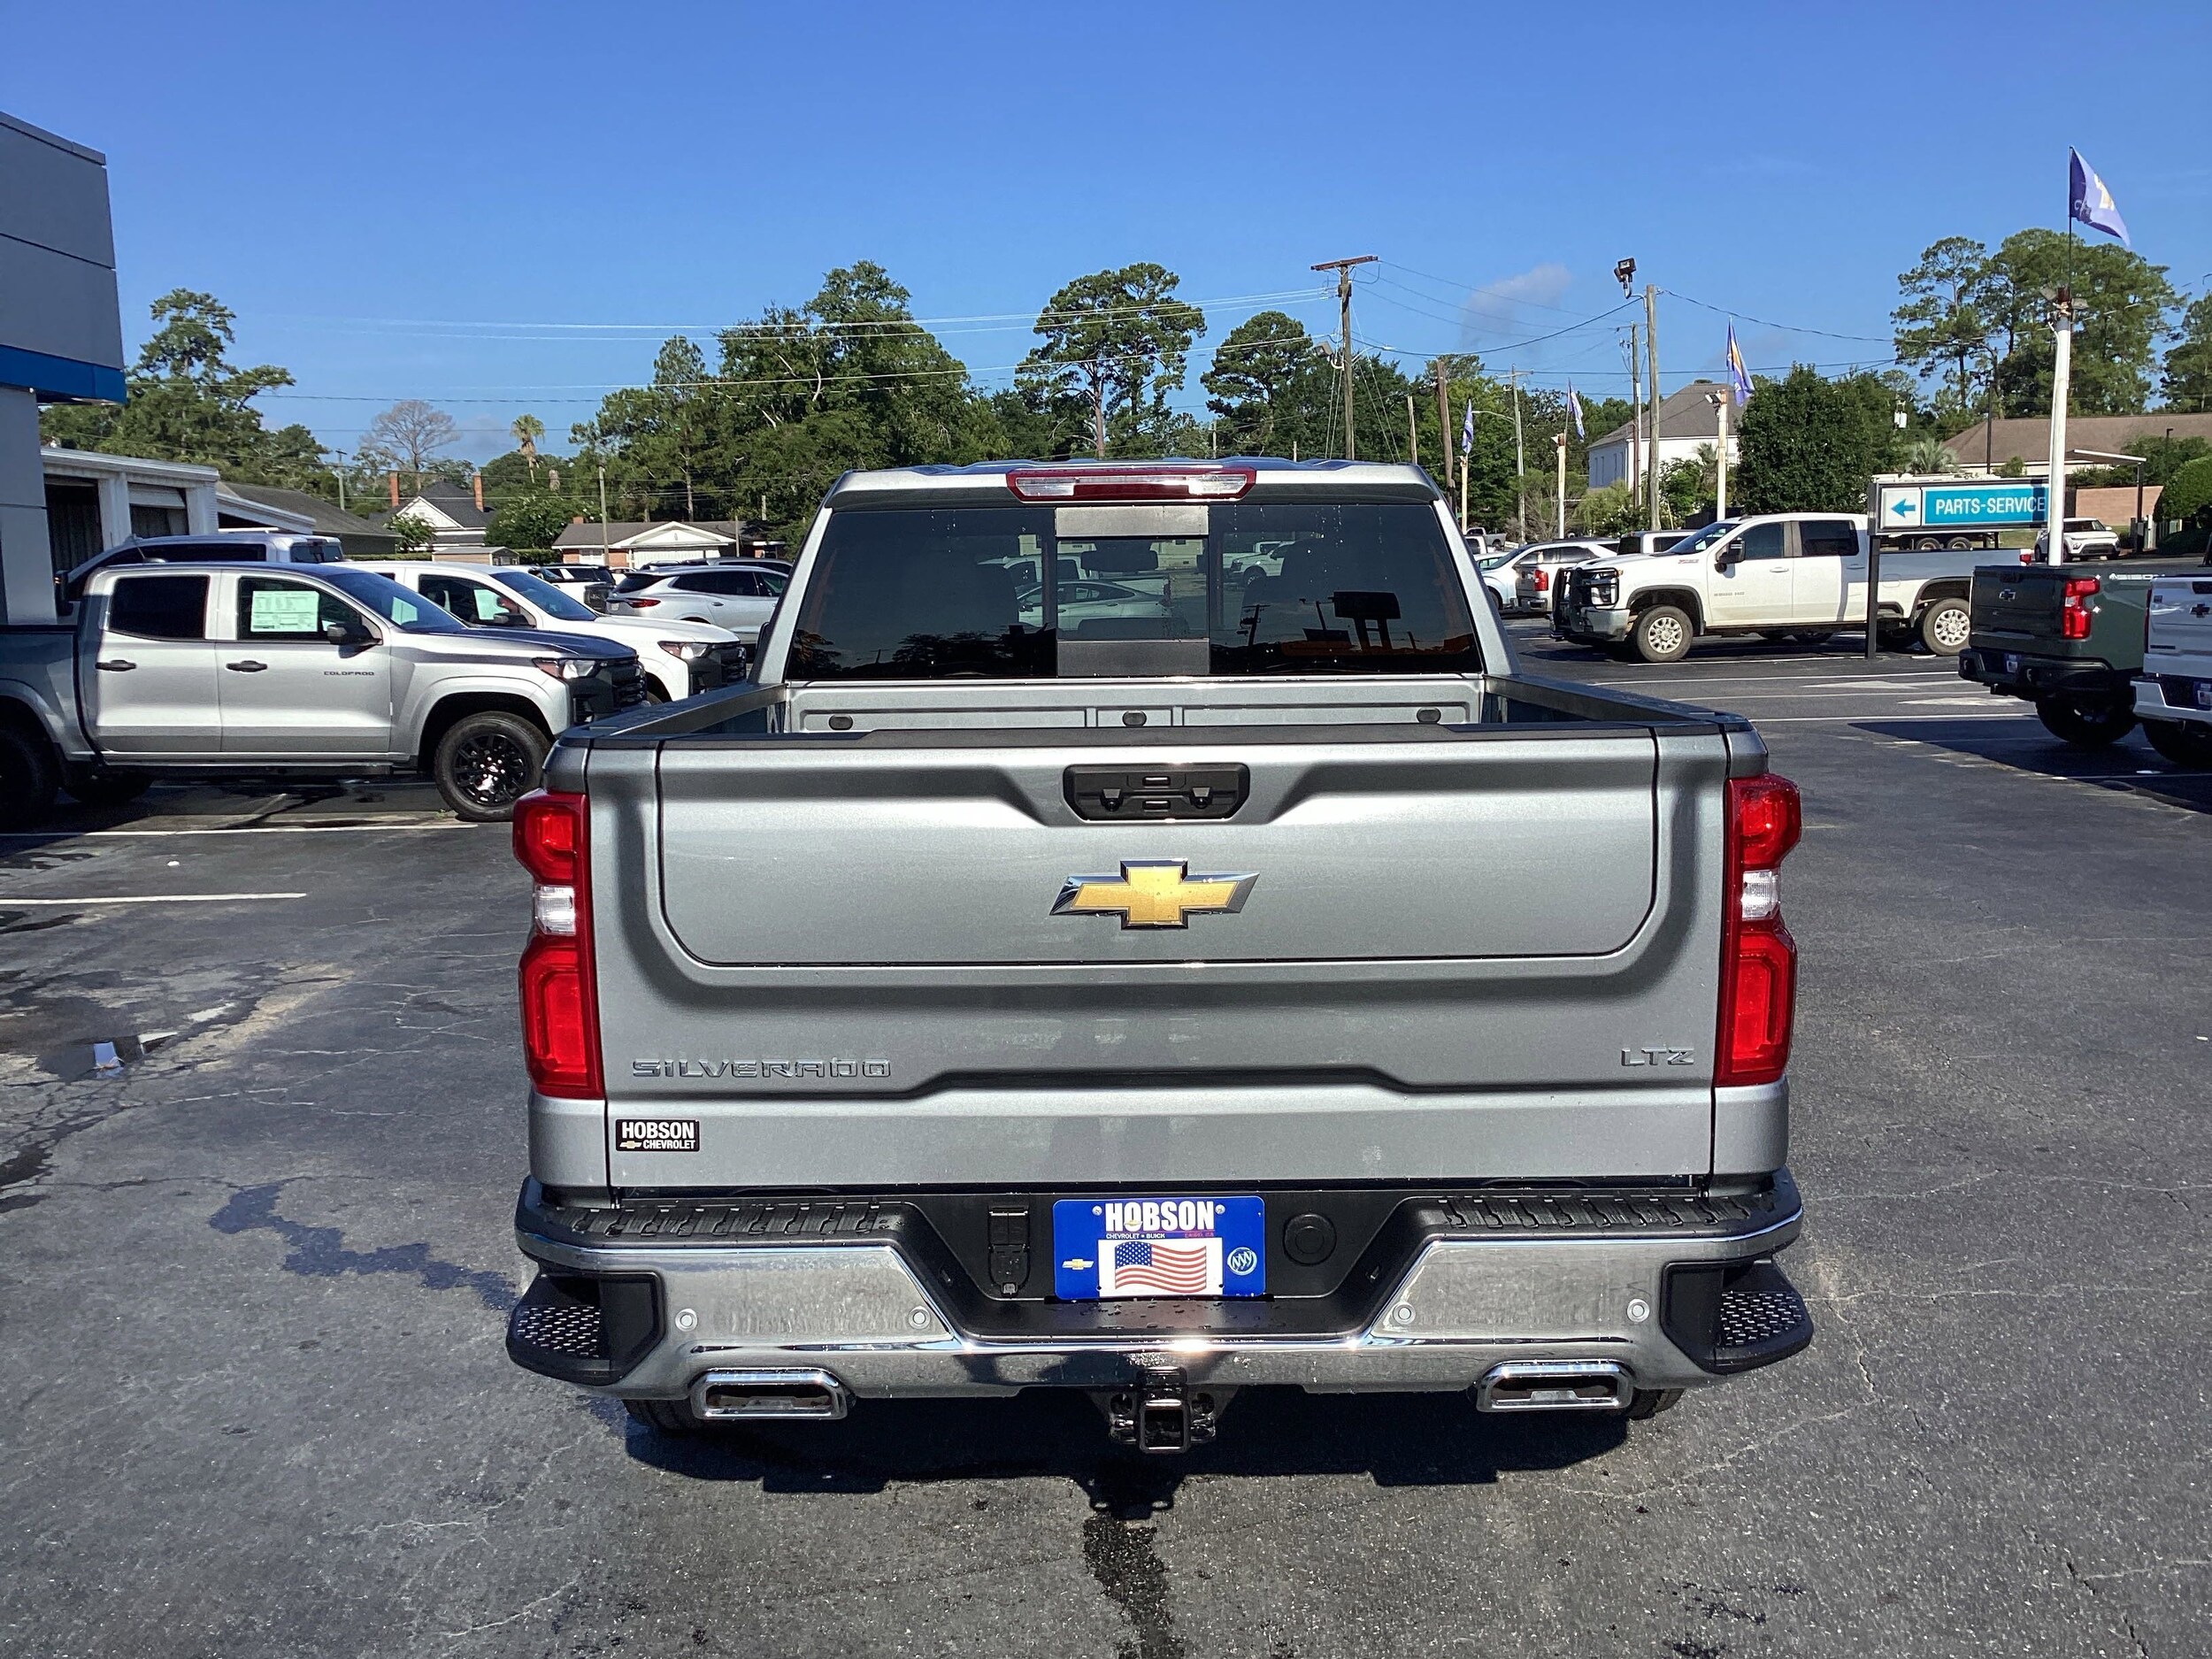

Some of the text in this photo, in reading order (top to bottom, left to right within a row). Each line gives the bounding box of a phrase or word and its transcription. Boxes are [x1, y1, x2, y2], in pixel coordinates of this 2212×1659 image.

[1935, 496, 2047, 515] PARTS-SERVICE
[1621, 1047, 1694, 1066] LTZ
[632, 1056, 892, 1079] SILVERADO
[621, 1121, 695, 1140] HOBSON
[642, 1140, 696, 1150] CHEVROLET
[1105, 1201, 1215, 1232] HOBSON
